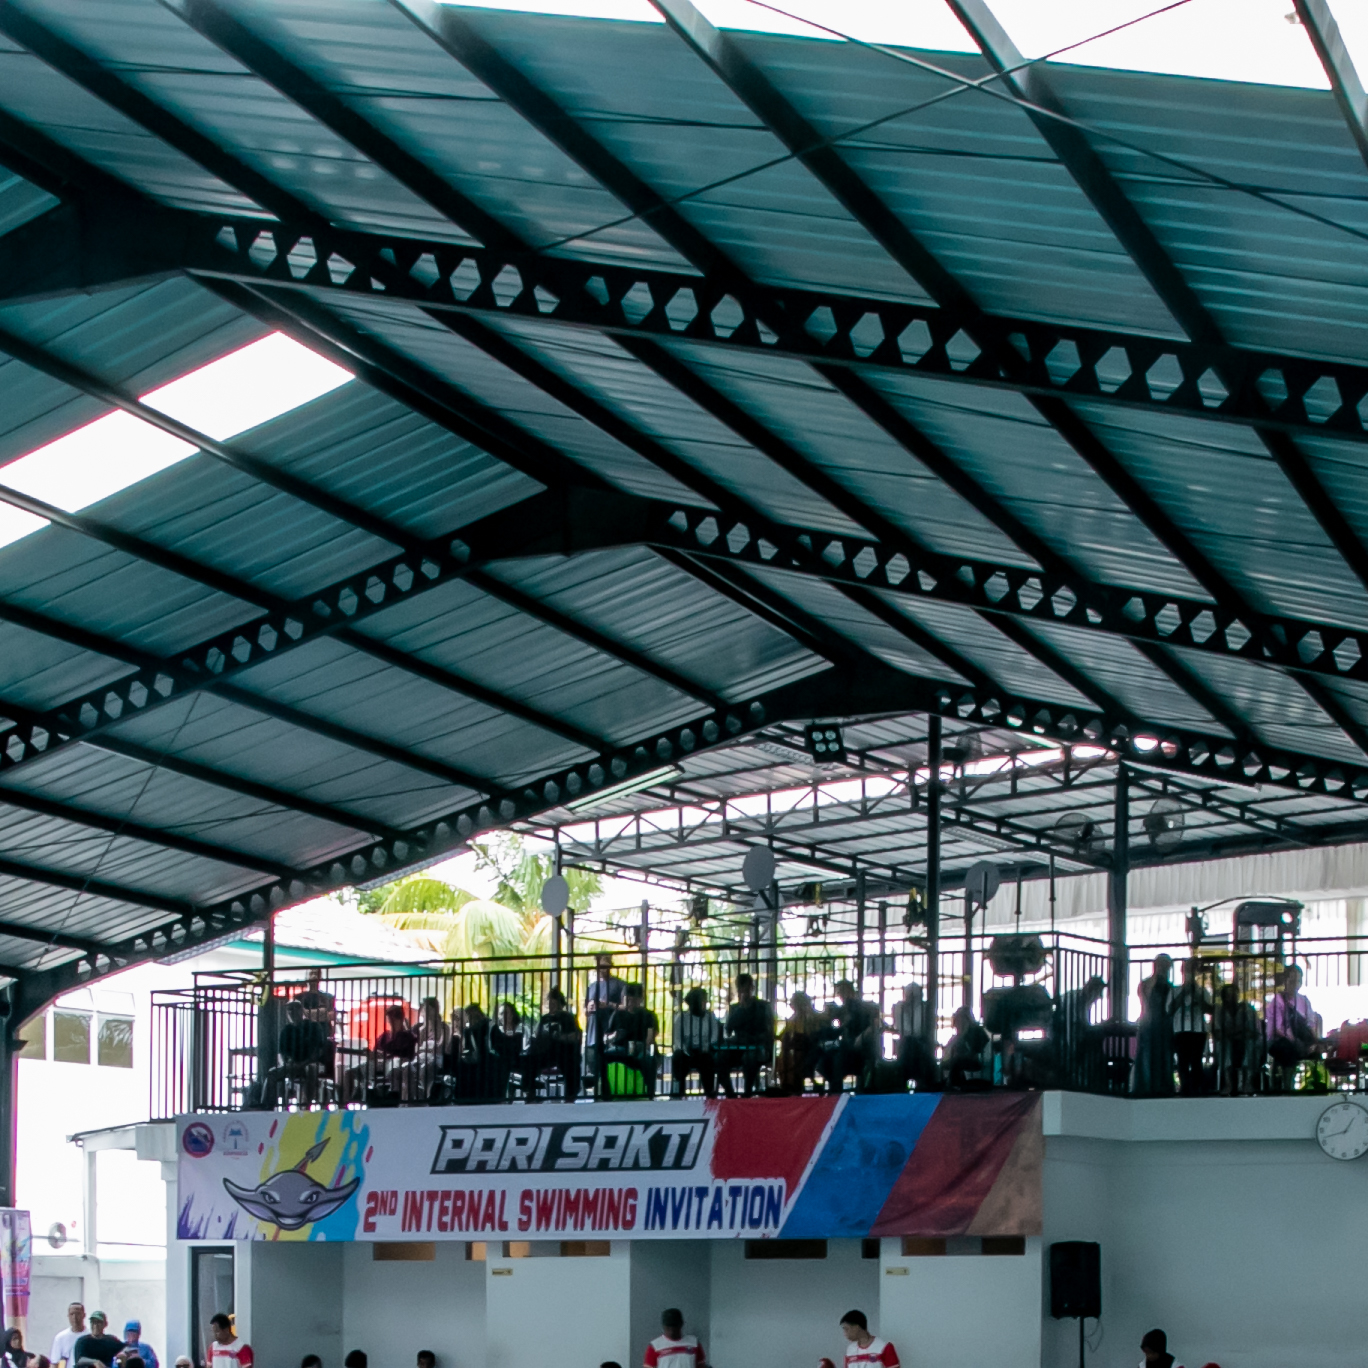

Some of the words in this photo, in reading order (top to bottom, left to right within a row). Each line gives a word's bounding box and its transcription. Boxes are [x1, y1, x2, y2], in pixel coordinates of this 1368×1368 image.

[435, 1128, 552, 1171] PARI
[555, 1123, 706, 1169] SAKTI
[363, 1190, 397, 1233] 2ND
[401, 1189, 509, 1232] INTERNAL
[518, 1187, 638, 1231] SWIMMING
[644, 1184, 783, 1231] INVITATION
